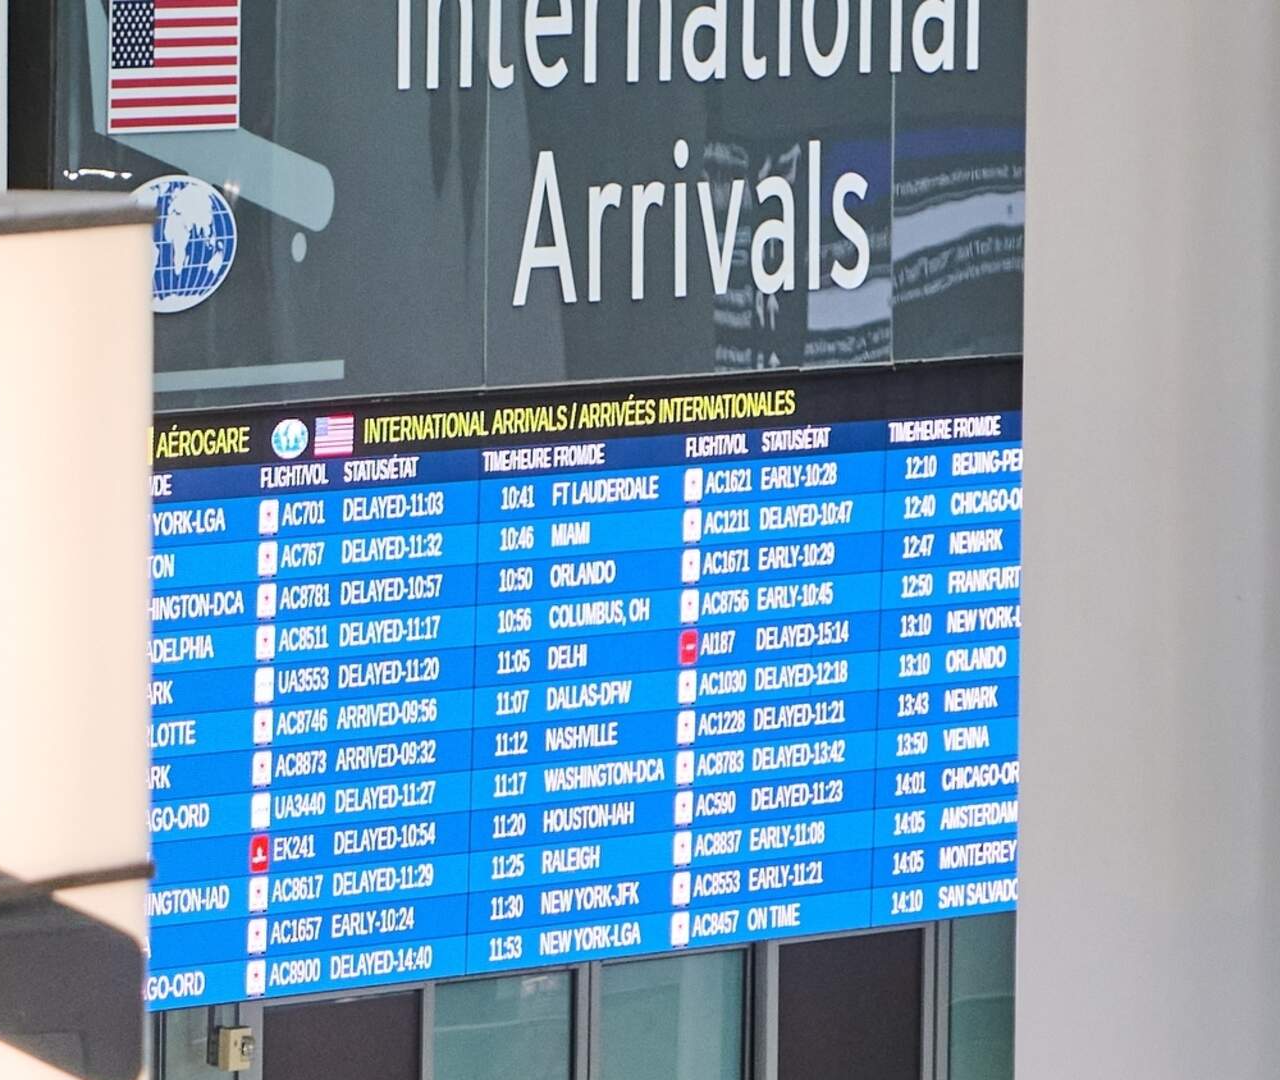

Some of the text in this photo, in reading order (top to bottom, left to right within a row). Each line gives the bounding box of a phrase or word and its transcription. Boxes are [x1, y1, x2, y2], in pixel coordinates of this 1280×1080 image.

[512, 139, 870, 307] Arrivals
[364, 411, 488, 445] INTERNATIONAL
[491, 405, 568, 437] ARRIVALS
[579, 393, 655, 429] ARRIVÉES
[658, 389, 796, 424] INTERNATIONALES
[156, 424, 250, 460] AÉROGARE
[501, 484, 535, 510] 10:41
[552, 481, 571, 506] FT
[571, 475, 659, 505] LAUDERDALE
[760, 462, 838, 490] EARLY-10:28
[342, 491, 444, 522] DELAYED-11:03
[500, 526, 534, 551] 10:46
[551, 521, 591, 547] MIAMI
[759, 500, 853, 530] DELAYED-10:47
[341, 532, 443, 564] DELAYED-11:32
[902, 528, 1003, 559] 12:47 NEWARK
[499, 566, 533, 592] 10:50
[550, 559, 616, 588] ORLANDO
[758, 541, 835, 571] EARLY-10:29
[340, 574, 443, 606] DELAYED-10:57
[498, 607, 532, 634] 10:56
[549, 599, 627, 629] COLUMBUS,
[628, 598, 650, 622] OH
[757, 581, 833, 611] EARLY-10:45
[339, 615, 441, 647] DELAYED-11:17
[497, 648, 531, 675] 11:05
[547, 644, 588, 670] DELHI
[756, 620, 849, 651] DELAYED-15:14
[338, 656, 440, 689] DELAYED-11:20
[899, 645, 1007, 678] 13:10 ORLANDO
[495, 689, 529, 715] 11:07
[546, 680, 632, 711] DALLAS-DFW
[755, 660, 848, 691] DELAYED-12:18
[336, 698, 437, 729] ARRIVED-09:56
[495, 730, 528, 757] 11:12
[545, 721, 618, 751] NASHVILLE
[753, 700, 845, 731] DELAYED-11:21
[335, 739, 436, 771] ARRIVED-09:32
[896, 725, 990, 757] 13:50 VIENNA
[494, 771, 527, 798] 11:17
[544, 758, 665, 792] WASHINGTON-DCA
[752, 739, 846, 771] DELAYED-13:42
[335, 780, 436, 814] DELAYED-11:27
[492, 812, 526, 839] 11:20
[543, 801, 635, 833] HOUSTON-IAH
[751, 779, 843, 811] DELAYED-11:23
[334, 822, 436, 855] DELAYED-10:54
[491, 853, 525, 880] 11:25
[542, 845, 601, 874] RALEIGH
[750, 821, 825, 851] EARLY-11:08
[332, 863, 434, 897] DELAYED-11:29
[490, 894, 524, 921] 11:30
[541, 888, 574, 915] NEW
[574, 881, 639, 910] YORK-JFK
[748, 861, 823, 892] EARLY-11:21
[331, 907, 415, 938] EARLY-10:24
[489, 935, 523, 962] 11:53
[539, 929, 573, 955] NEW
[573, 922, 641, 951] YORK-LGA
[747, 907, 768, 931] ON
[769, 903, 801, 928] TIME
[330, 945, 432, 980] DELAYED-14:40
